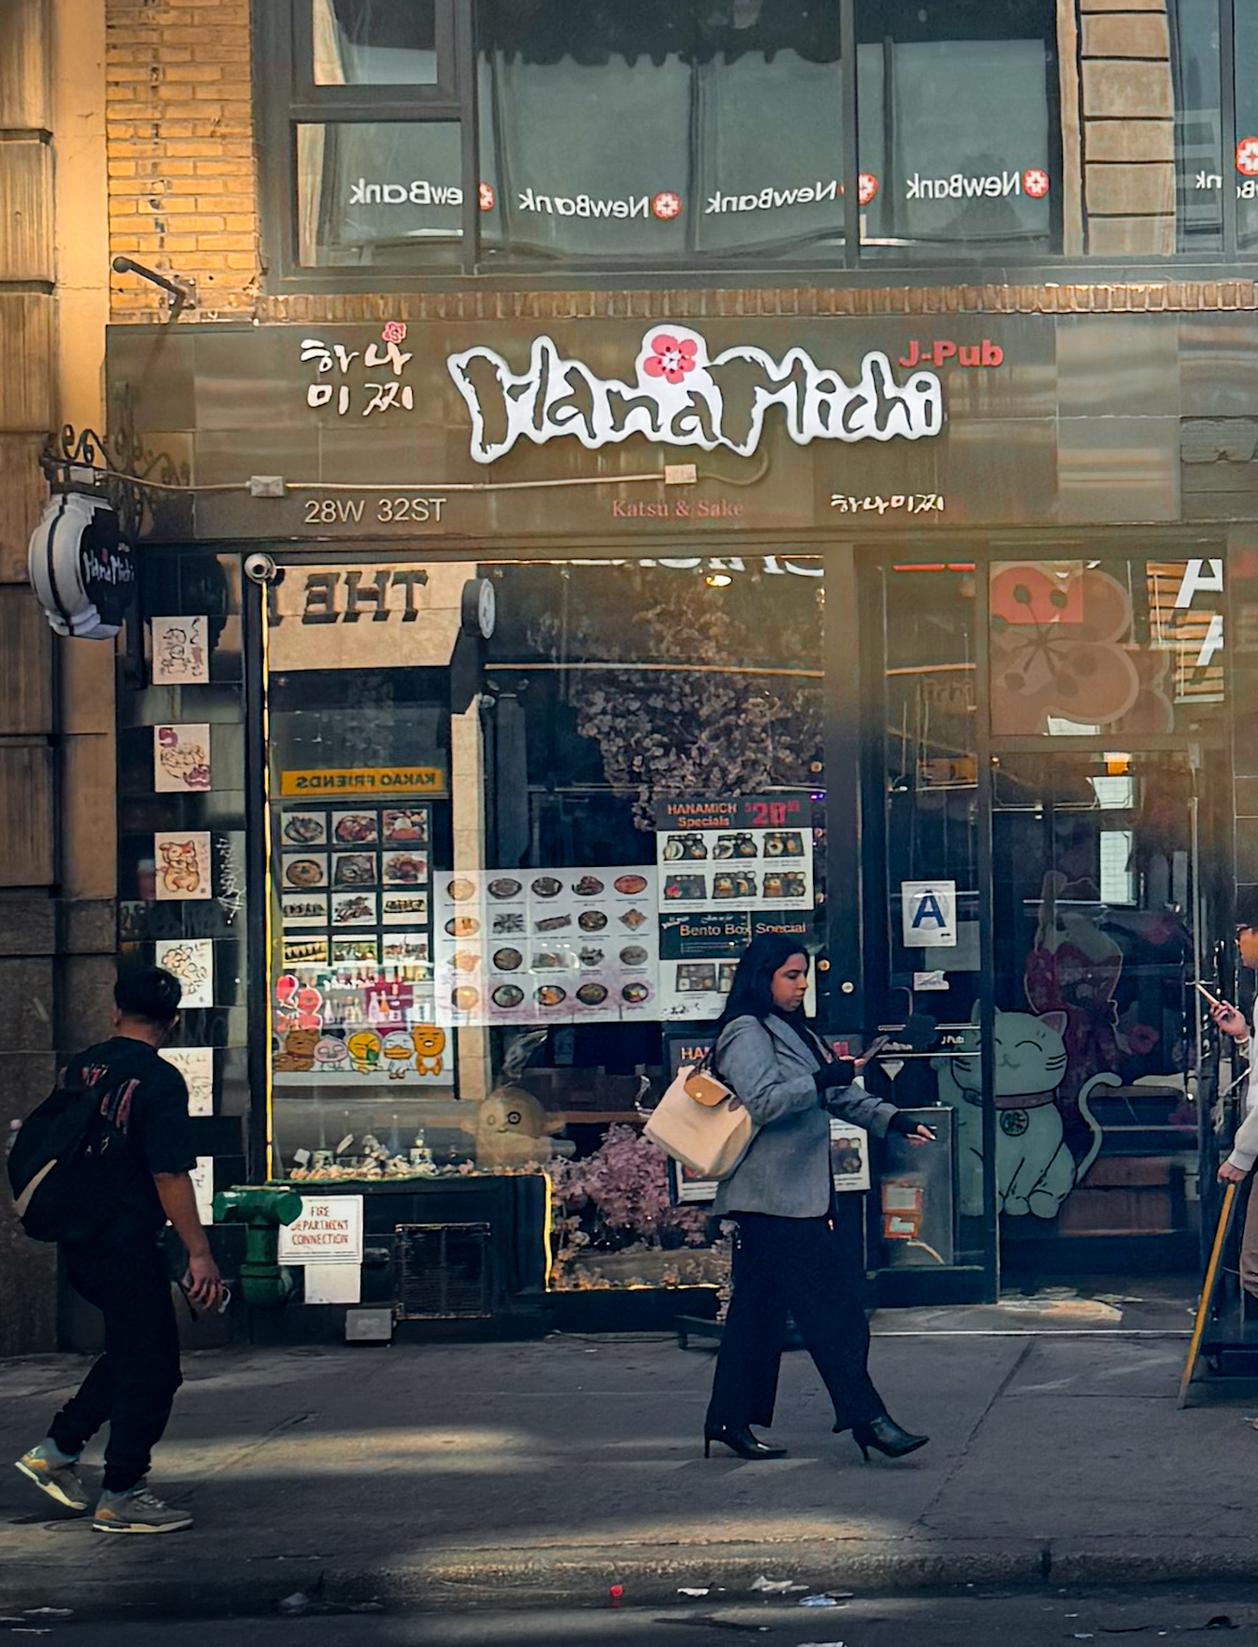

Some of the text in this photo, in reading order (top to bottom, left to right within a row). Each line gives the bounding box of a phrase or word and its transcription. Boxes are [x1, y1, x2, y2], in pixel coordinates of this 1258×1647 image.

[300, 338, 413, 375] 하나
[899, 339, 1004, 369] J-Pub
[304, 497, 447, 524] 28W 32ST
[612, 498, 744, 519] Katsu & Sake
[911, 889, 946, 929] A
[679, 924, 722, 937] Bento
[310, 1206, 329, 1217] FIRE
[291, 1234, 349, 1246] CONNECTION
